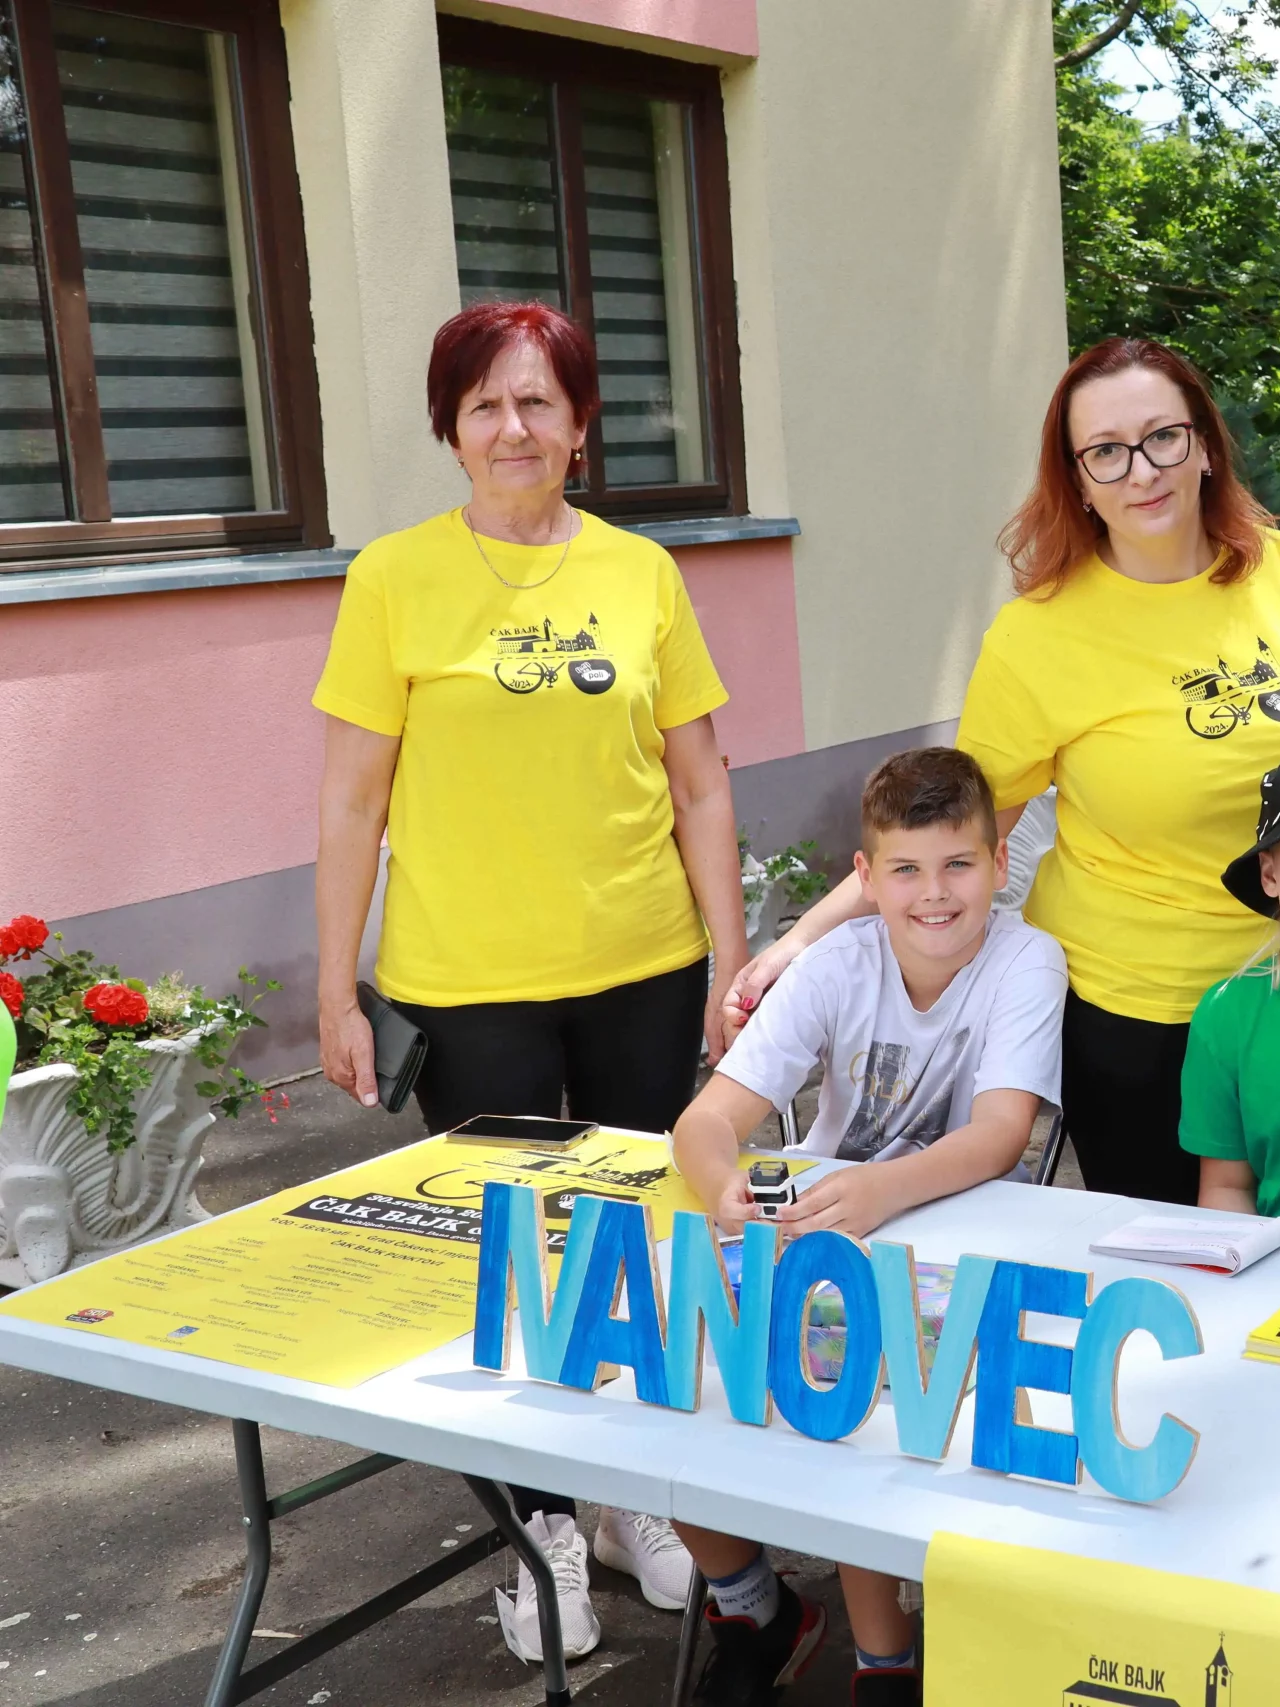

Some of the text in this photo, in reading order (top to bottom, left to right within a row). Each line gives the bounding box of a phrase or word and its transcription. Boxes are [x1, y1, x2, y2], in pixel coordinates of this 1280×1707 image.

[490, 625, 539, 637] ČAK BAJK
[588, 671, 604, 680] poli
[1171, 671, 1193, 686] ČAK
[308, 1197, 381, 1219] ČAK
[376, 1209, 471, 1233] BAJK
[329, 1239, 357, 1251] ČAK
[353, 1243, 389, 1257] BAJK
[366, 1234, 394, 1246] Grad
[472, 1182, 1204, 1503] IVANOVEC
[1088, 1653, 1166, 1693] ČAK BAJK
